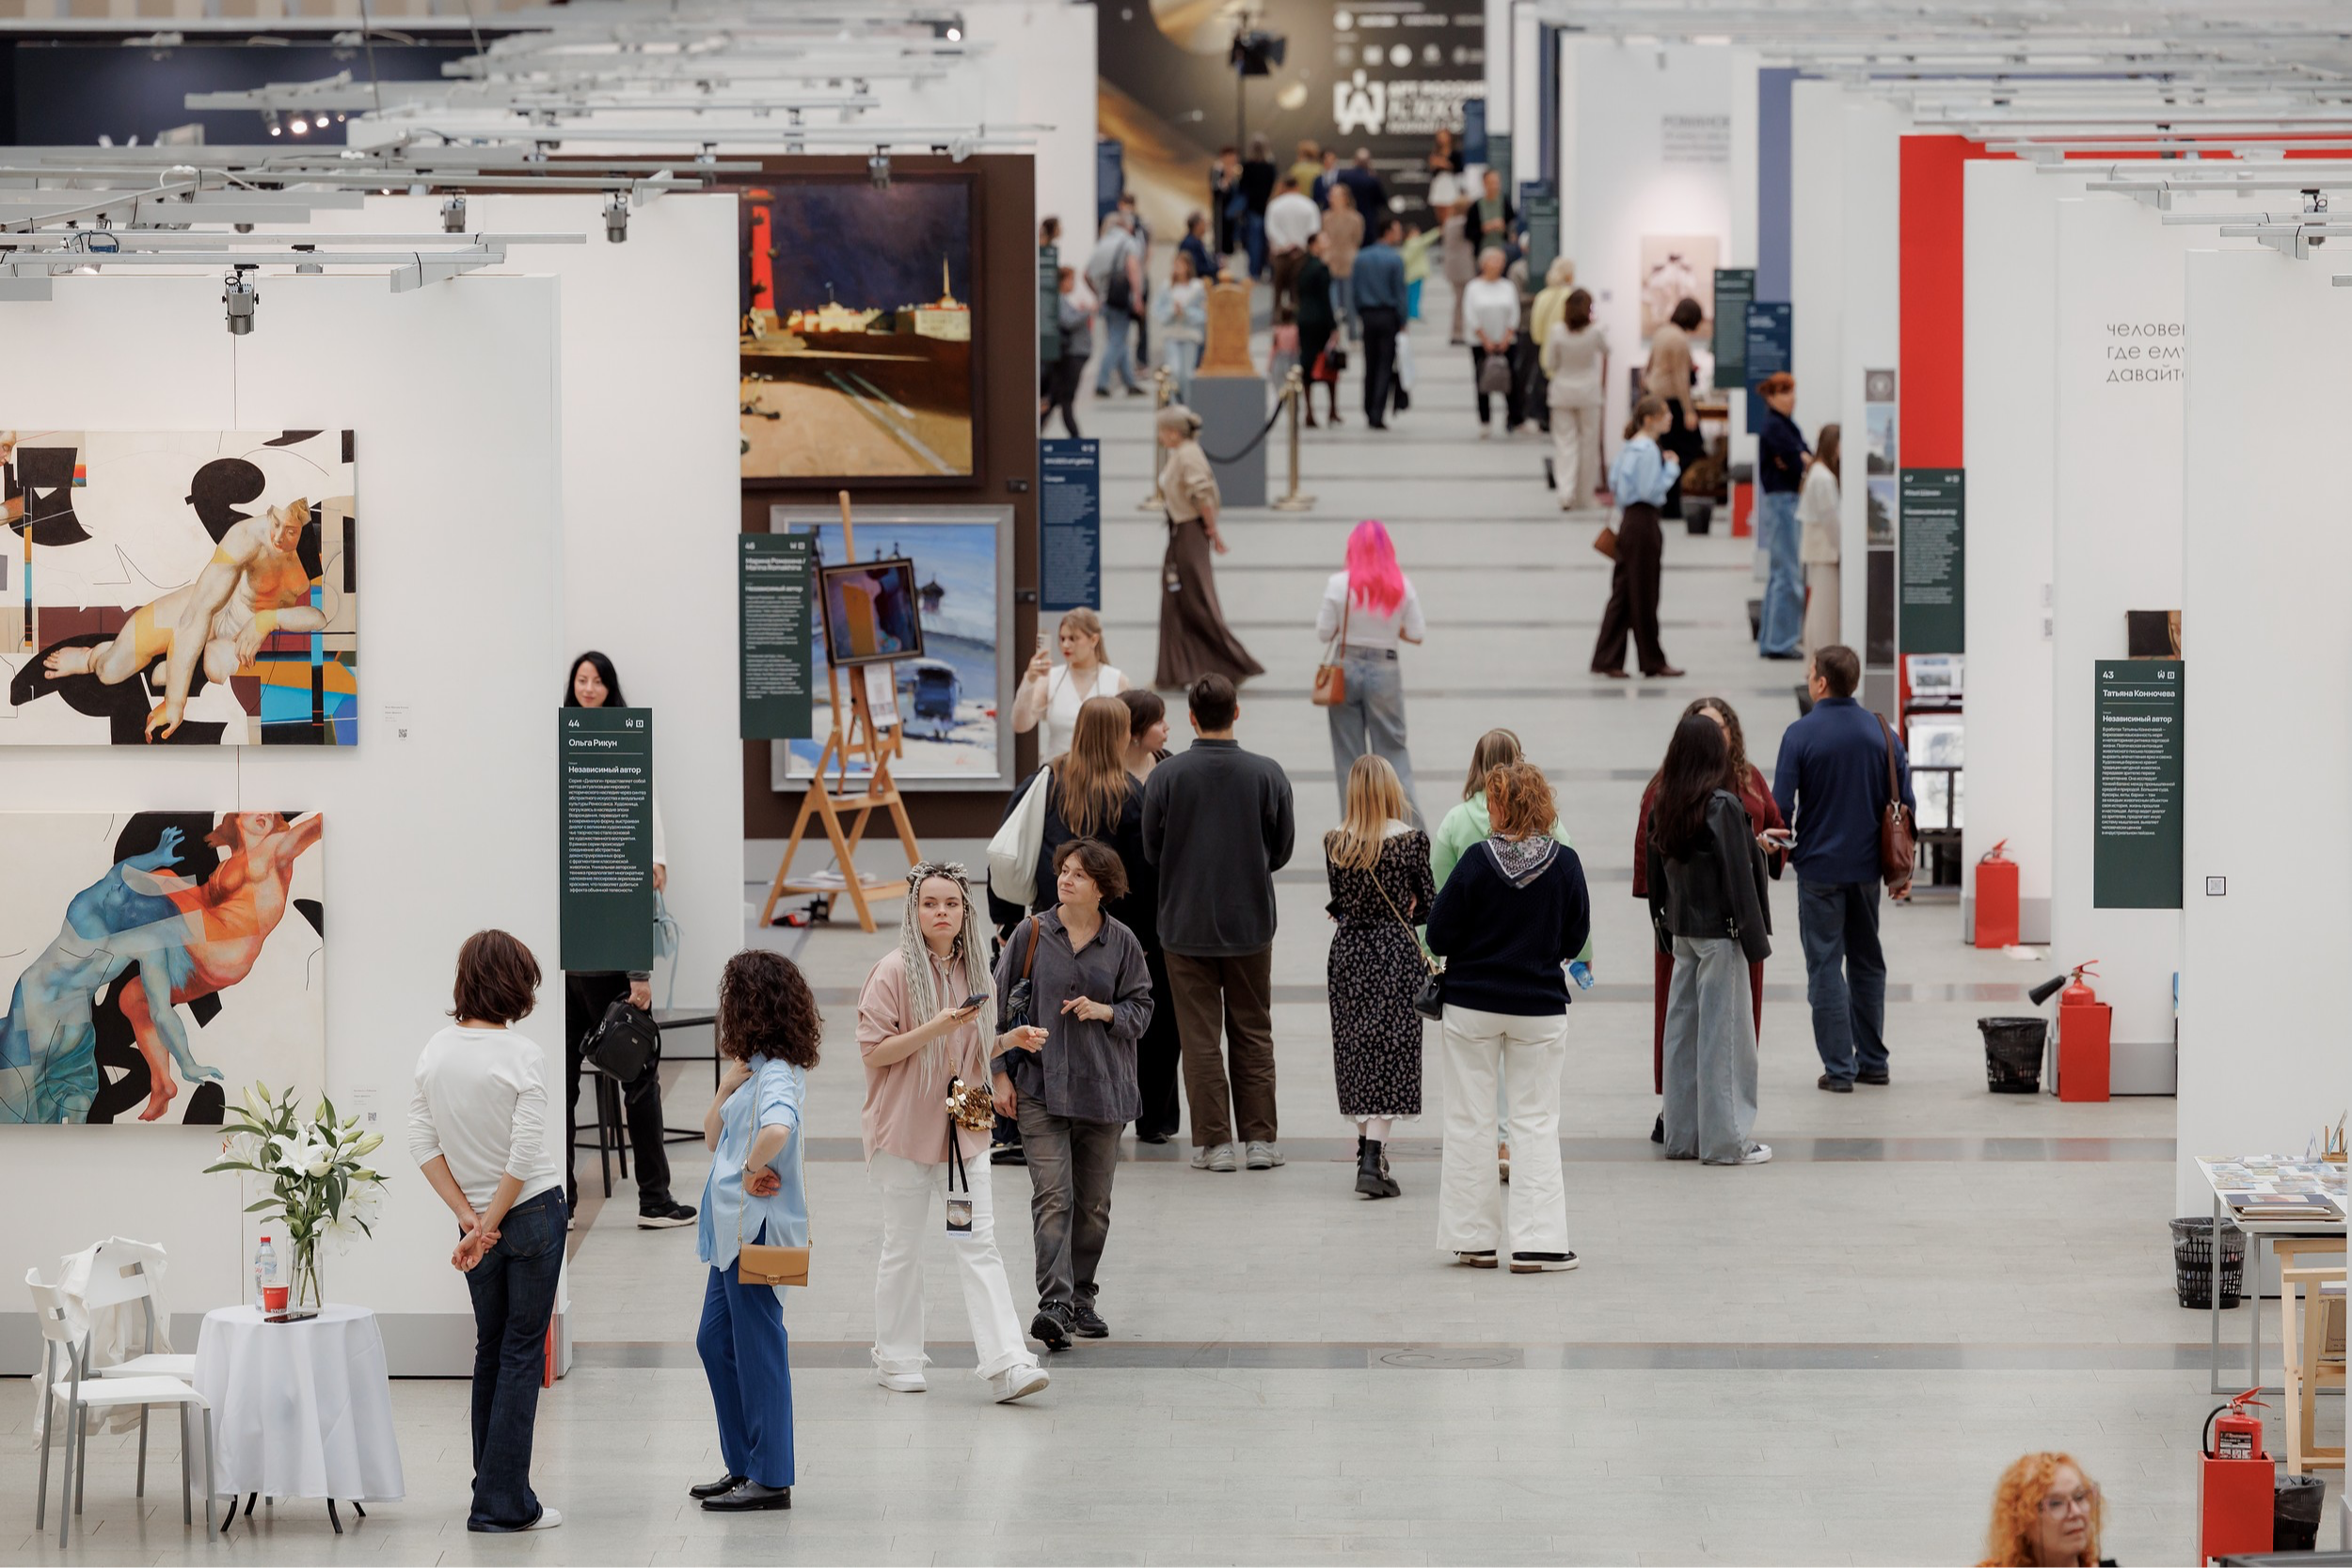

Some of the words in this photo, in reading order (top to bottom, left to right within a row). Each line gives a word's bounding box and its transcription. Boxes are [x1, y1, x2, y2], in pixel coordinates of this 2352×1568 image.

[2107, 346, 2141, 360] где
[2106, 364, 2184, 383] давайт
[568, 719, 580, 728] 44
[569, 739, 592, 747] Ольга
[593, 739, 617, 748] Рикун
